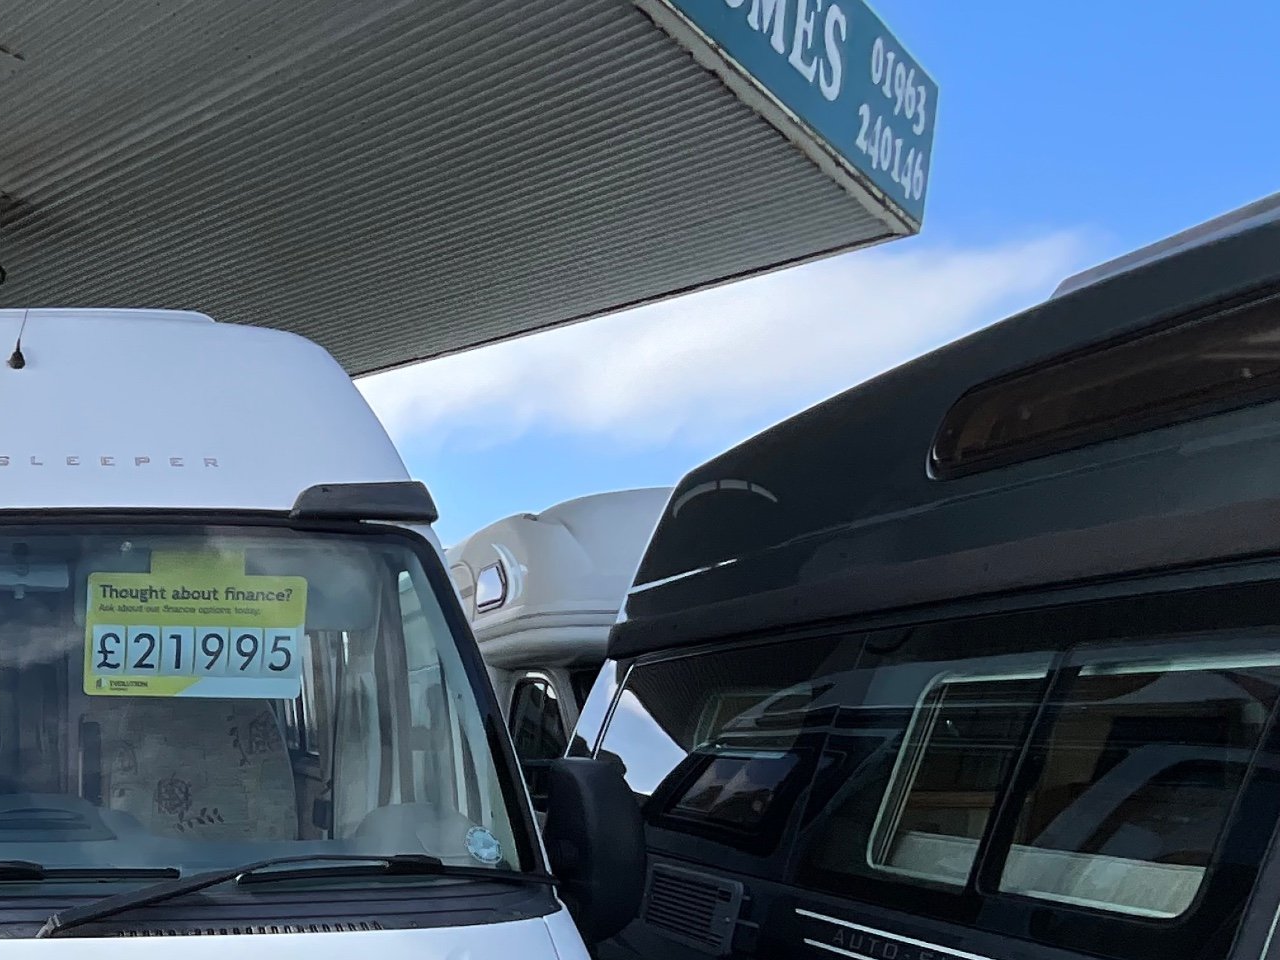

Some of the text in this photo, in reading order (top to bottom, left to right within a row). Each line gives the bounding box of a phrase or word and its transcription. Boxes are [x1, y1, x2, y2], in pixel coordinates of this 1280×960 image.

[726, 0, 847, 101] MES
[871, 37, 926, 136] 01963
[855, 103, 924, 200] 240146
[100, 584, 293, 603] Thought about finance?
[96, 632, 292, 672] £21995
